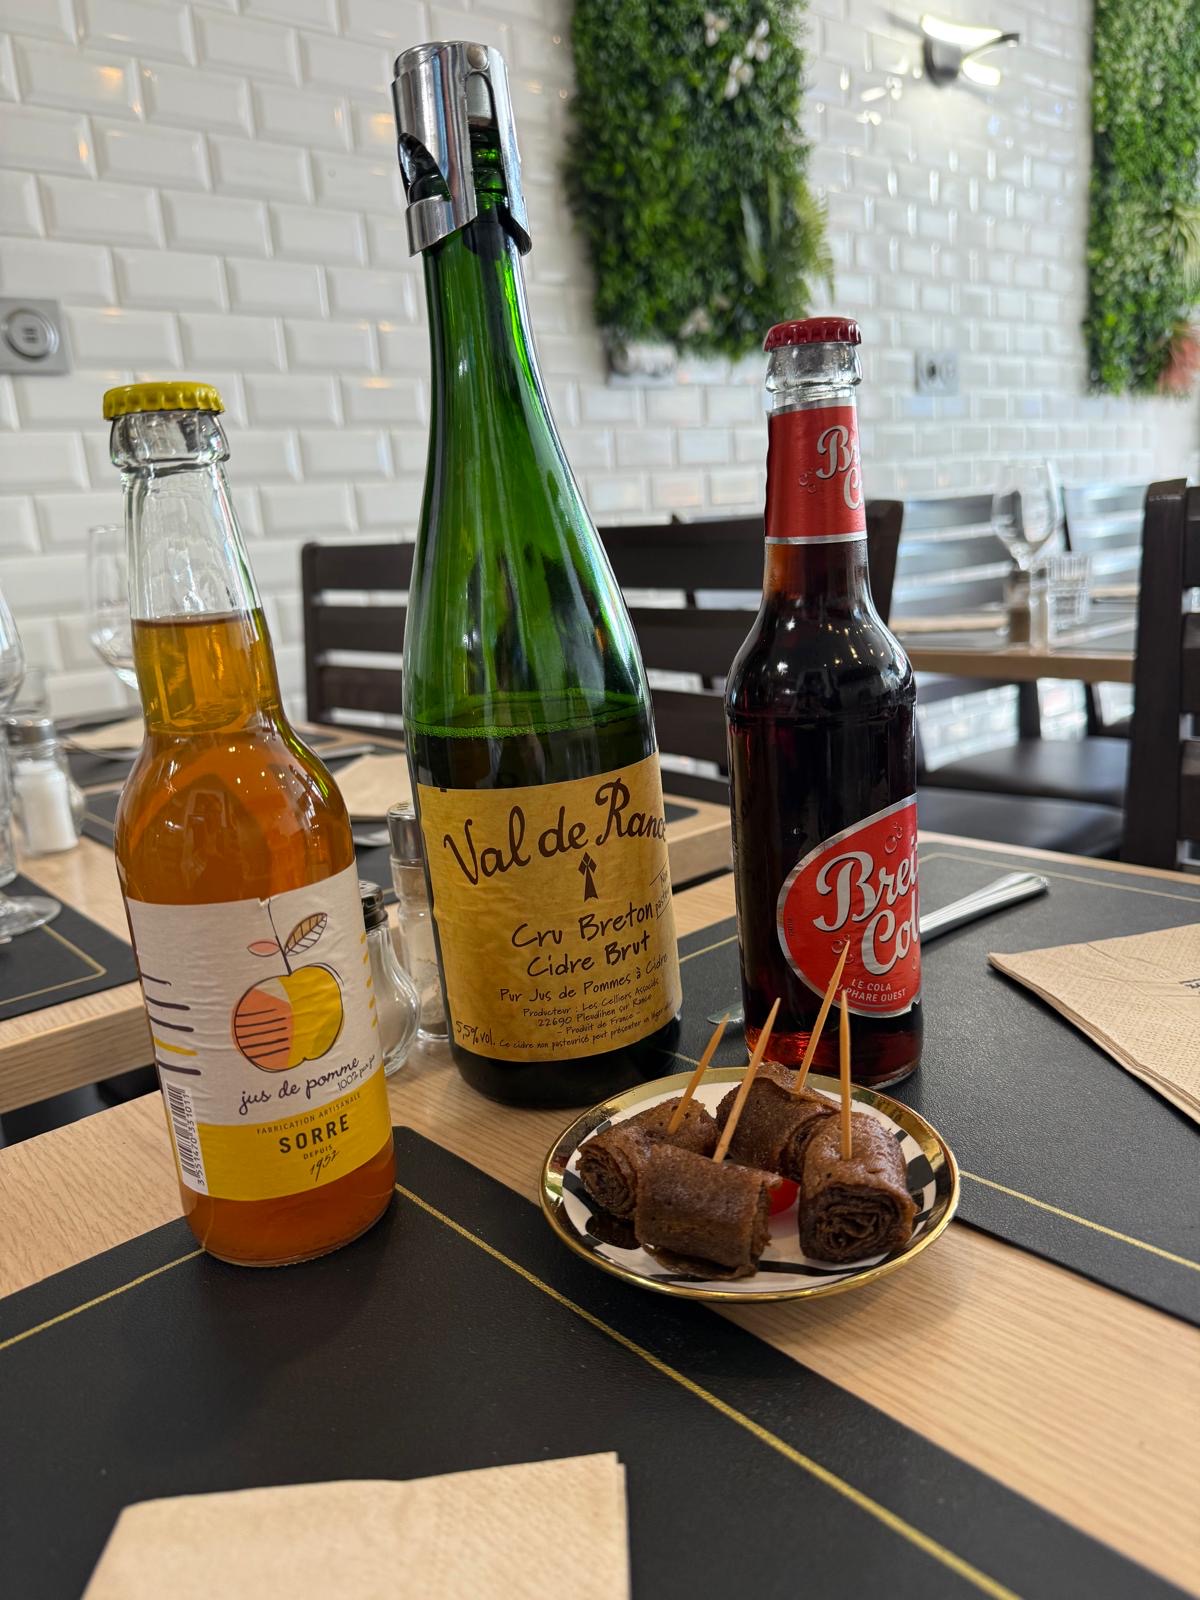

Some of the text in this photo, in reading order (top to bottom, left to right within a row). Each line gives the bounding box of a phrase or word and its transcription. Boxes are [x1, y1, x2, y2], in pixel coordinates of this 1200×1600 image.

[443, 805, 531, 886] Val
[538, 805, 589, 858] de
[812, 834, 919, 932] Brei
[511, 901, 653, 948] Cru Breton
[861, 889, 919, 975] Col
[527, 930, 650, 977] Cidre Brut
[500, 988, 522, 1002] Pur
[528, 988, 552, 1002] Jus
[558, 985, 577, 999] de
[583, 973, 631, 995] Pommes
[846, 987, 878, 1002] PHARE
[881, 988, 906, 1002] OUEST
[851, 978, 891, 992] LE COLA
[523, 1006, 571, 1017] Producteur
[582, 1003, 598, 1011] Les
[601, 991, 632, 1007] Celliers
[537, 1016, 572, 1028] 22690
[566, 1023, 594, 1035] Produit
[597, 1020, 608, 1029] de
[238, 1057, 360, 1116] jus de pomme
[257, 1115, 315, 1135] FABRICATION
[278, 1113, 349, 1154] SORRE
[303, 1143, 333, 1160] DEPUIS
